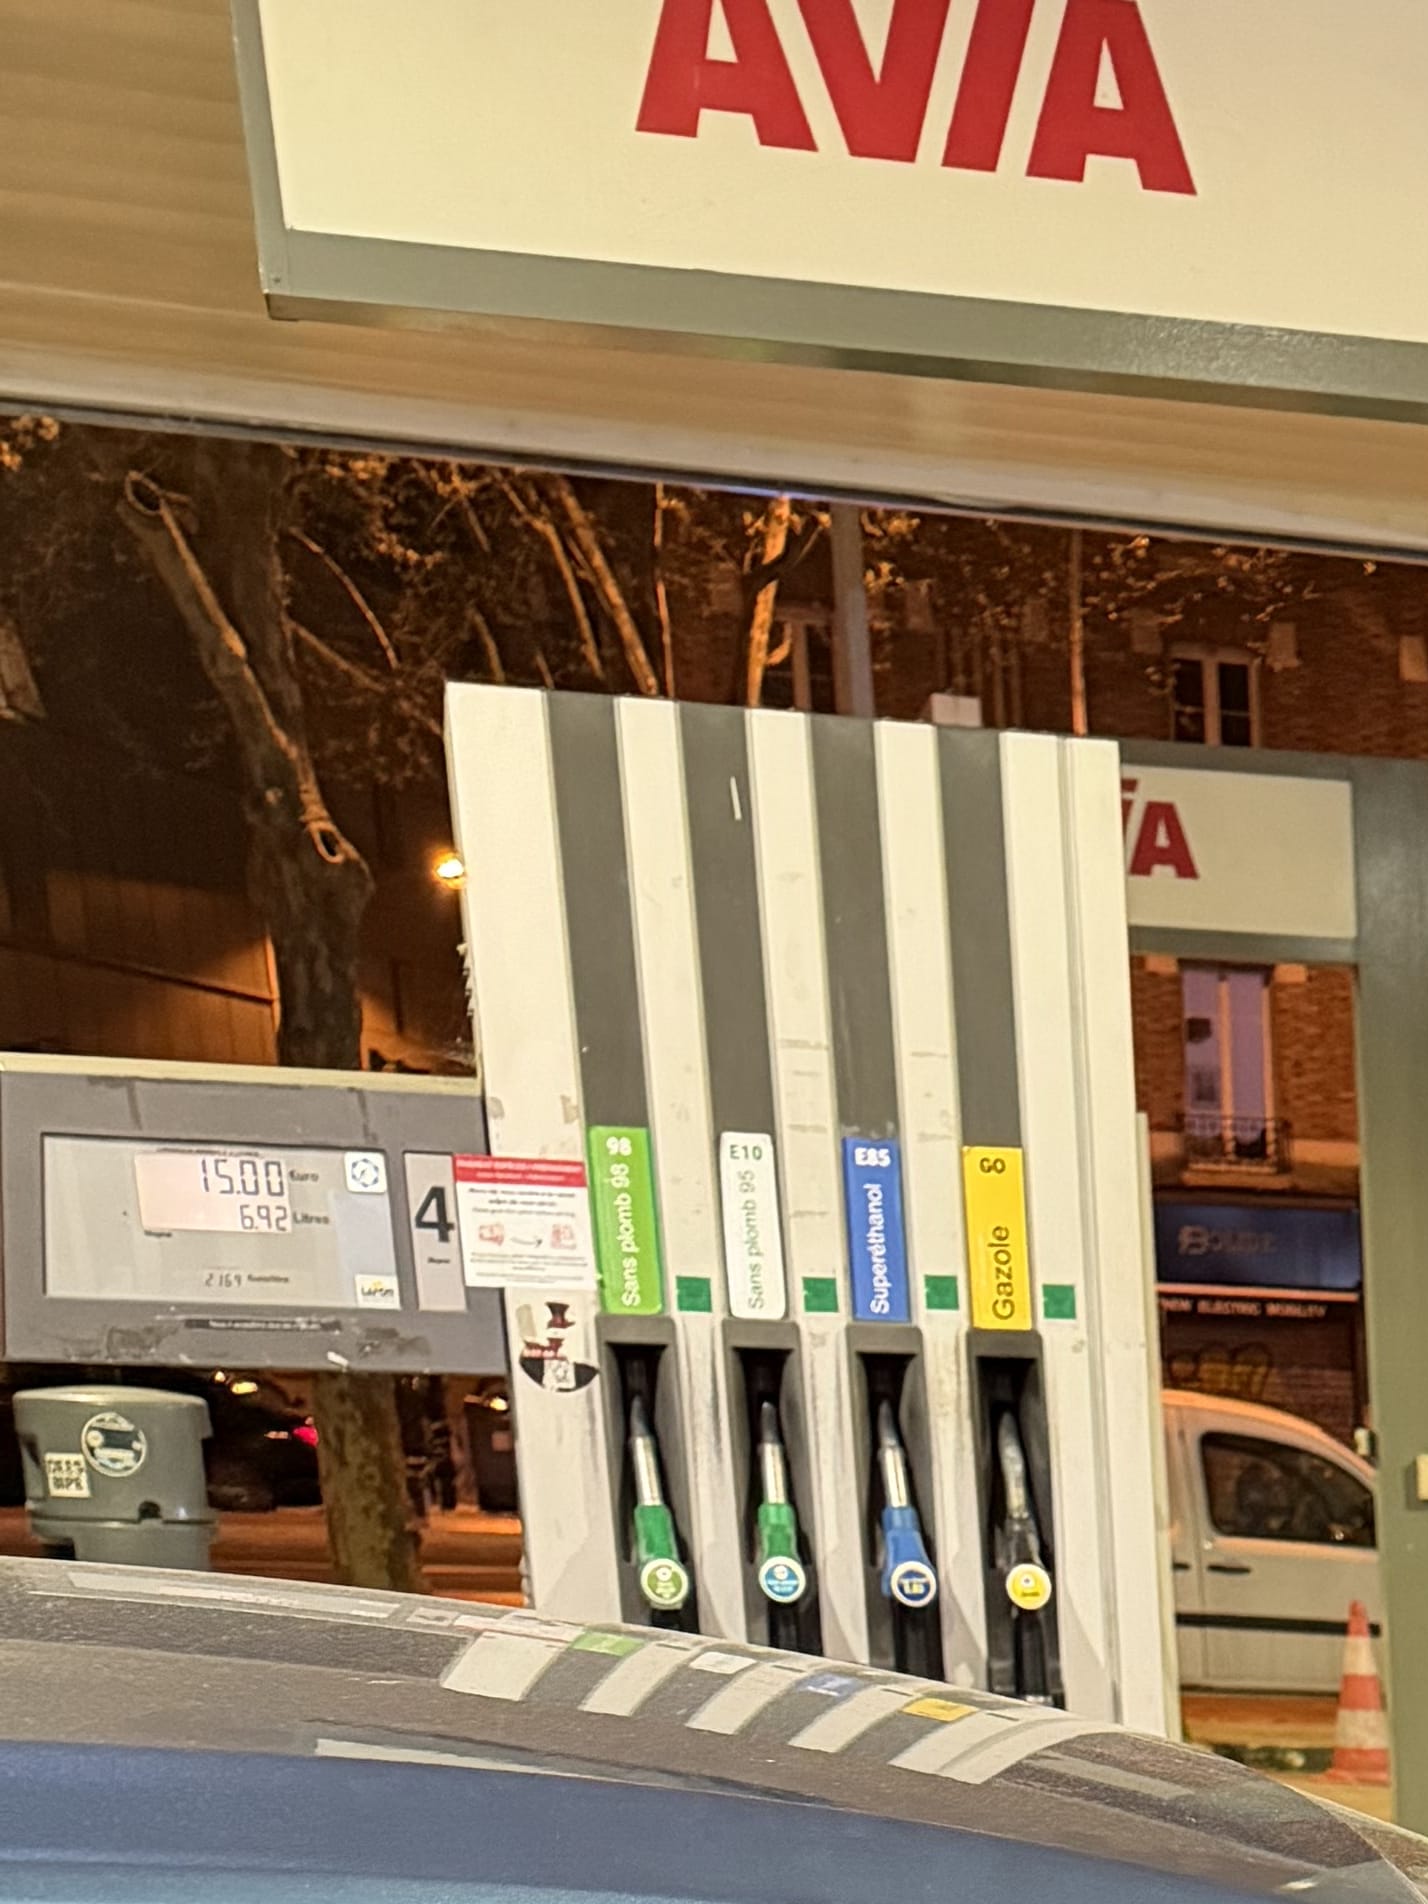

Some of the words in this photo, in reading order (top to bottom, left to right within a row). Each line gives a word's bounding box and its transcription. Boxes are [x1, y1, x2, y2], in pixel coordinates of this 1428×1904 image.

[636, 0, 1198, 196] AVIA
[606, 1136, 632, 1156] 98
[729, 1144, 763, 1161] E10
[854, 1147, 891, 1167] E85
[201, 1158, 285, 1196] 15.00
[610, 1163, 630, 1188] 98
[737, 1169, 756, 1193] 95
[240, 1204, 287, 1231] 6.92
[415, 1186, 455, 1243] 4
[613, 1192, 641, 1254] plomb
[741, 1199, 765, 1257] plomb
[621, 1257, 641, 1306] Sans
[749, 1264, 765, 1309] Sans
[987, 1225, 1016, 1320] Gazole
